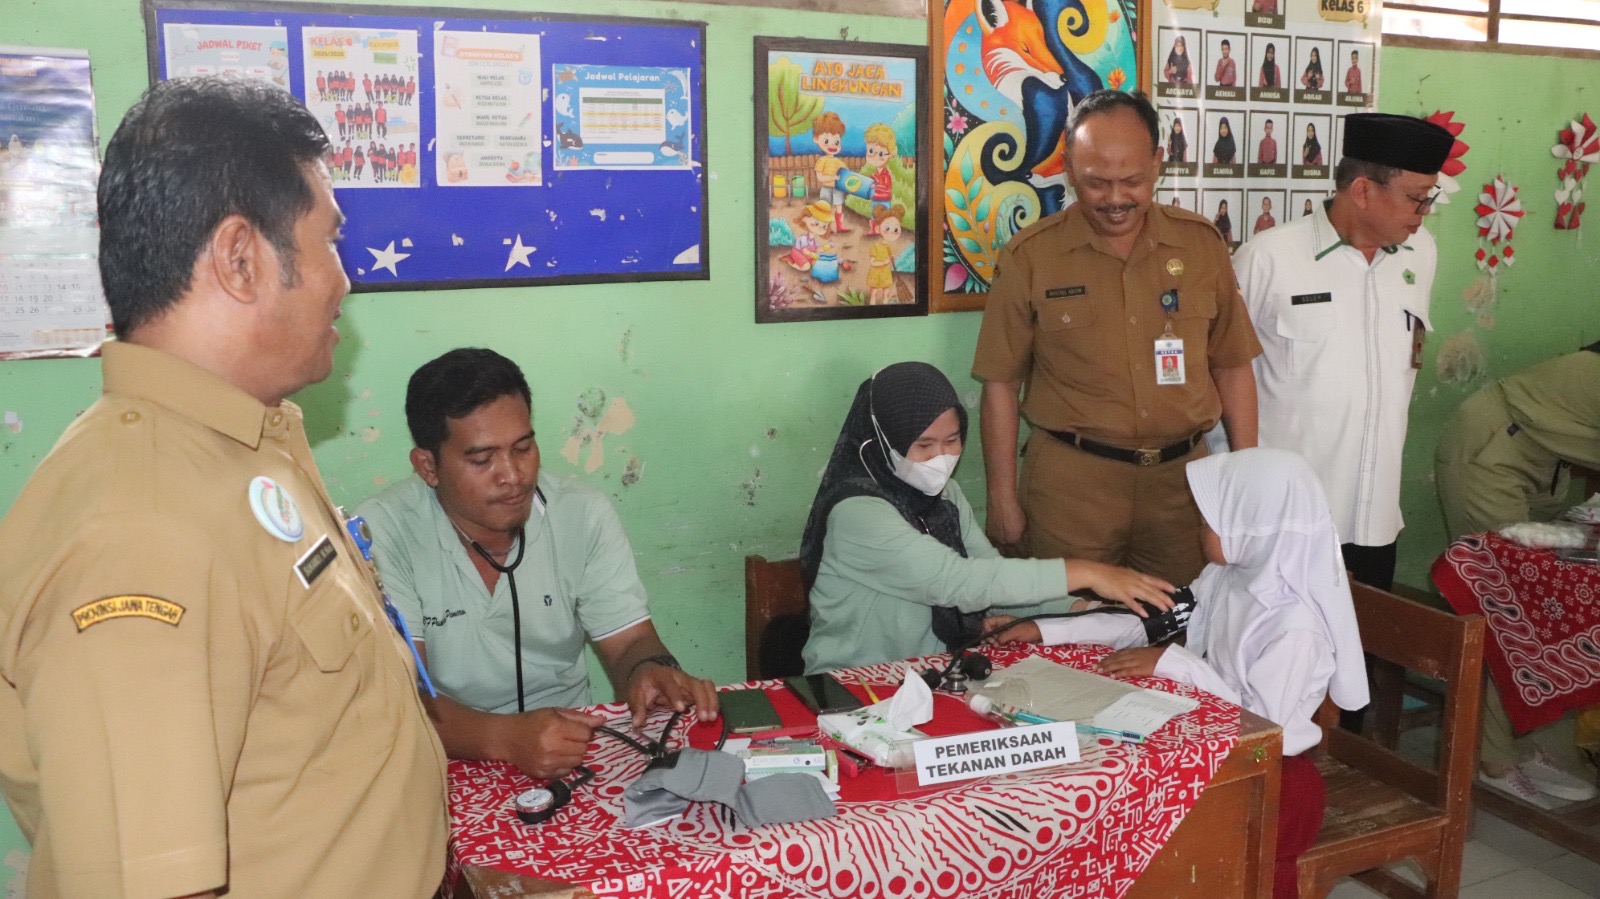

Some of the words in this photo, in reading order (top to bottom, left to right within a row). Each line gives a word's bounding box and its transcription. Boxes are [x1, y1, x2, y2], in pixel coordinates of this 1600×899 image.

[1357, 1, 1364, 13] 6
[197, 40, 234, 51] JADWAL
[236, 40, 263, 51] PIKET
[310, 37, 343, 47] KELAS
[585, 72, 616, 81] Jadwal
[618, 73, 660, 83] Pelajaran
[814, 61, 843, 76] AYO
[848, 63, 885, 80] JAGA
[801, 76, 902, 97] LINGKUNGAN
[935, 730, 1053, 759] PEMERIKSAAN
[925, 755, 1006, 778] TEKANAN
[1011, 746, 1066, 766] DARAH
